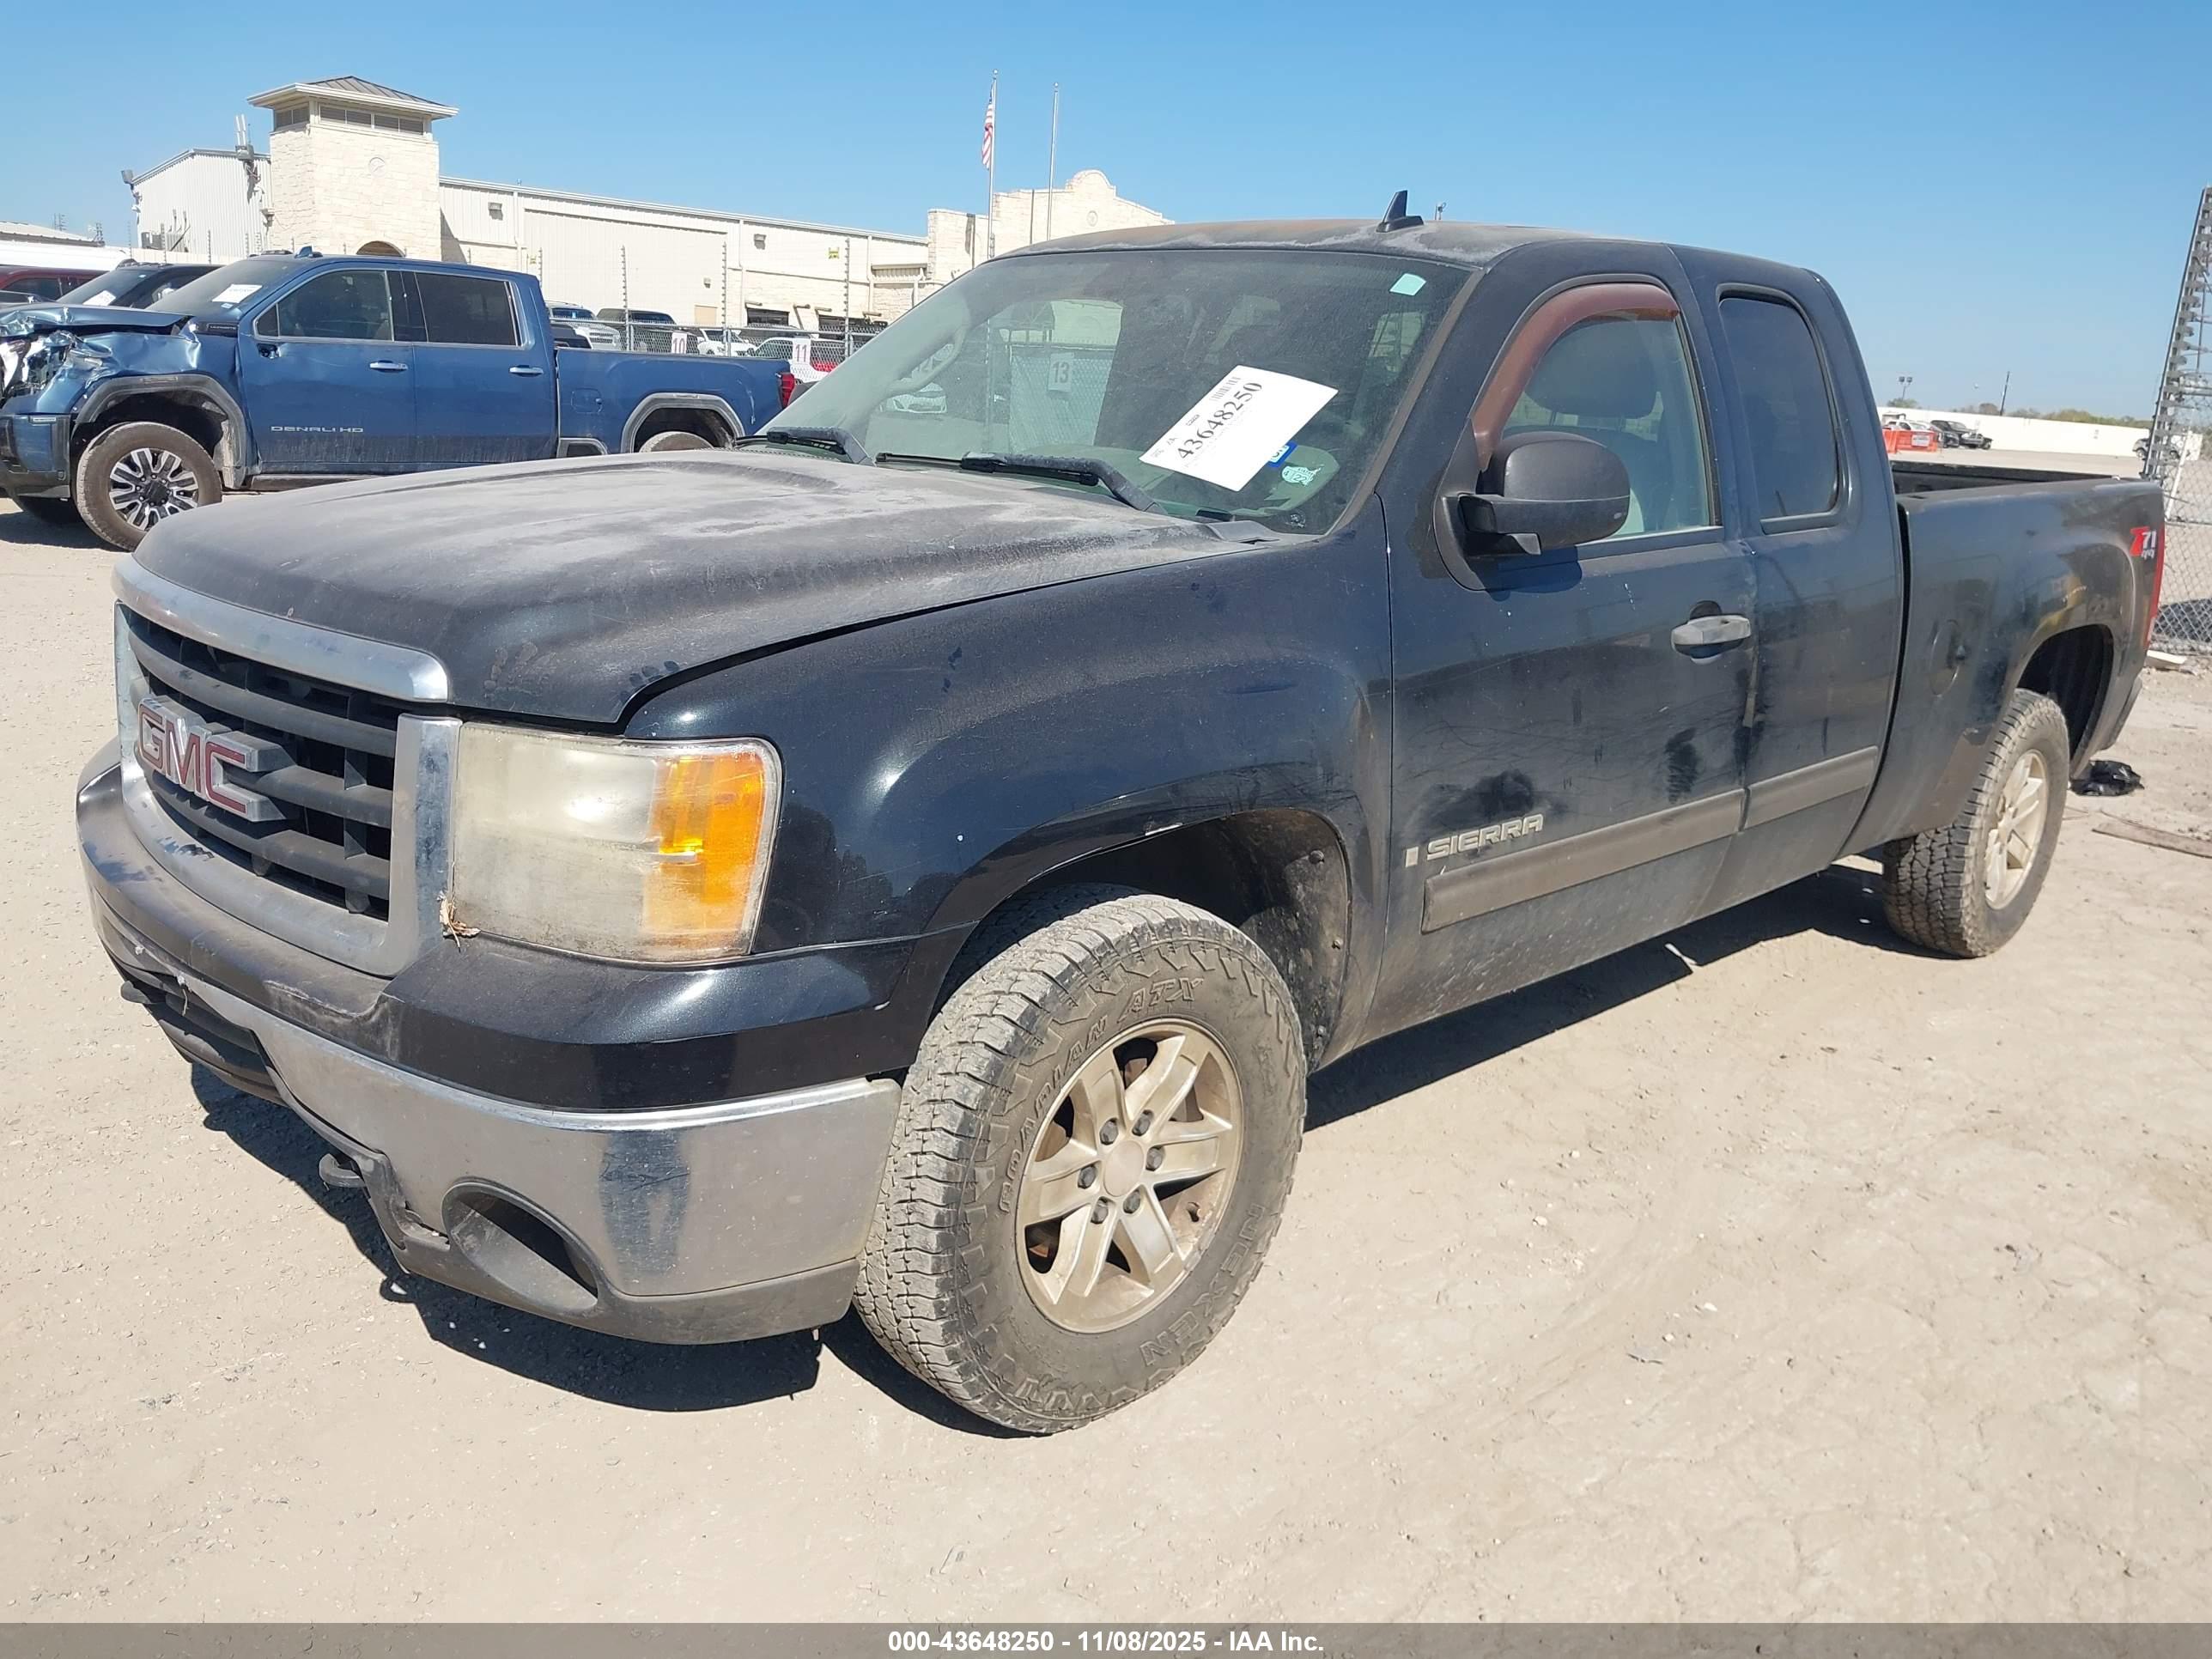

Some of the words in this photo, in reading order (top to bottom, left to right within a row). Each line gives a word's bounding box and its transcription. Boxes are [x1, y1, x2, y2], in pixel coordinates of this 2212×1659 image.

[673, 337, 686, 354] 10
[794, 343, 807, 363] 11
[1052, 361, 1069, 385] 13
[1177, 382, 1262, 459] 43648250
[138, 699, 270, 822] GMC
[1426, 814, 1544, 860] SIERRA
[1117, 977, 1204, 1024] ATX
[1139, 1202, 1266, 1366] NEXEN
